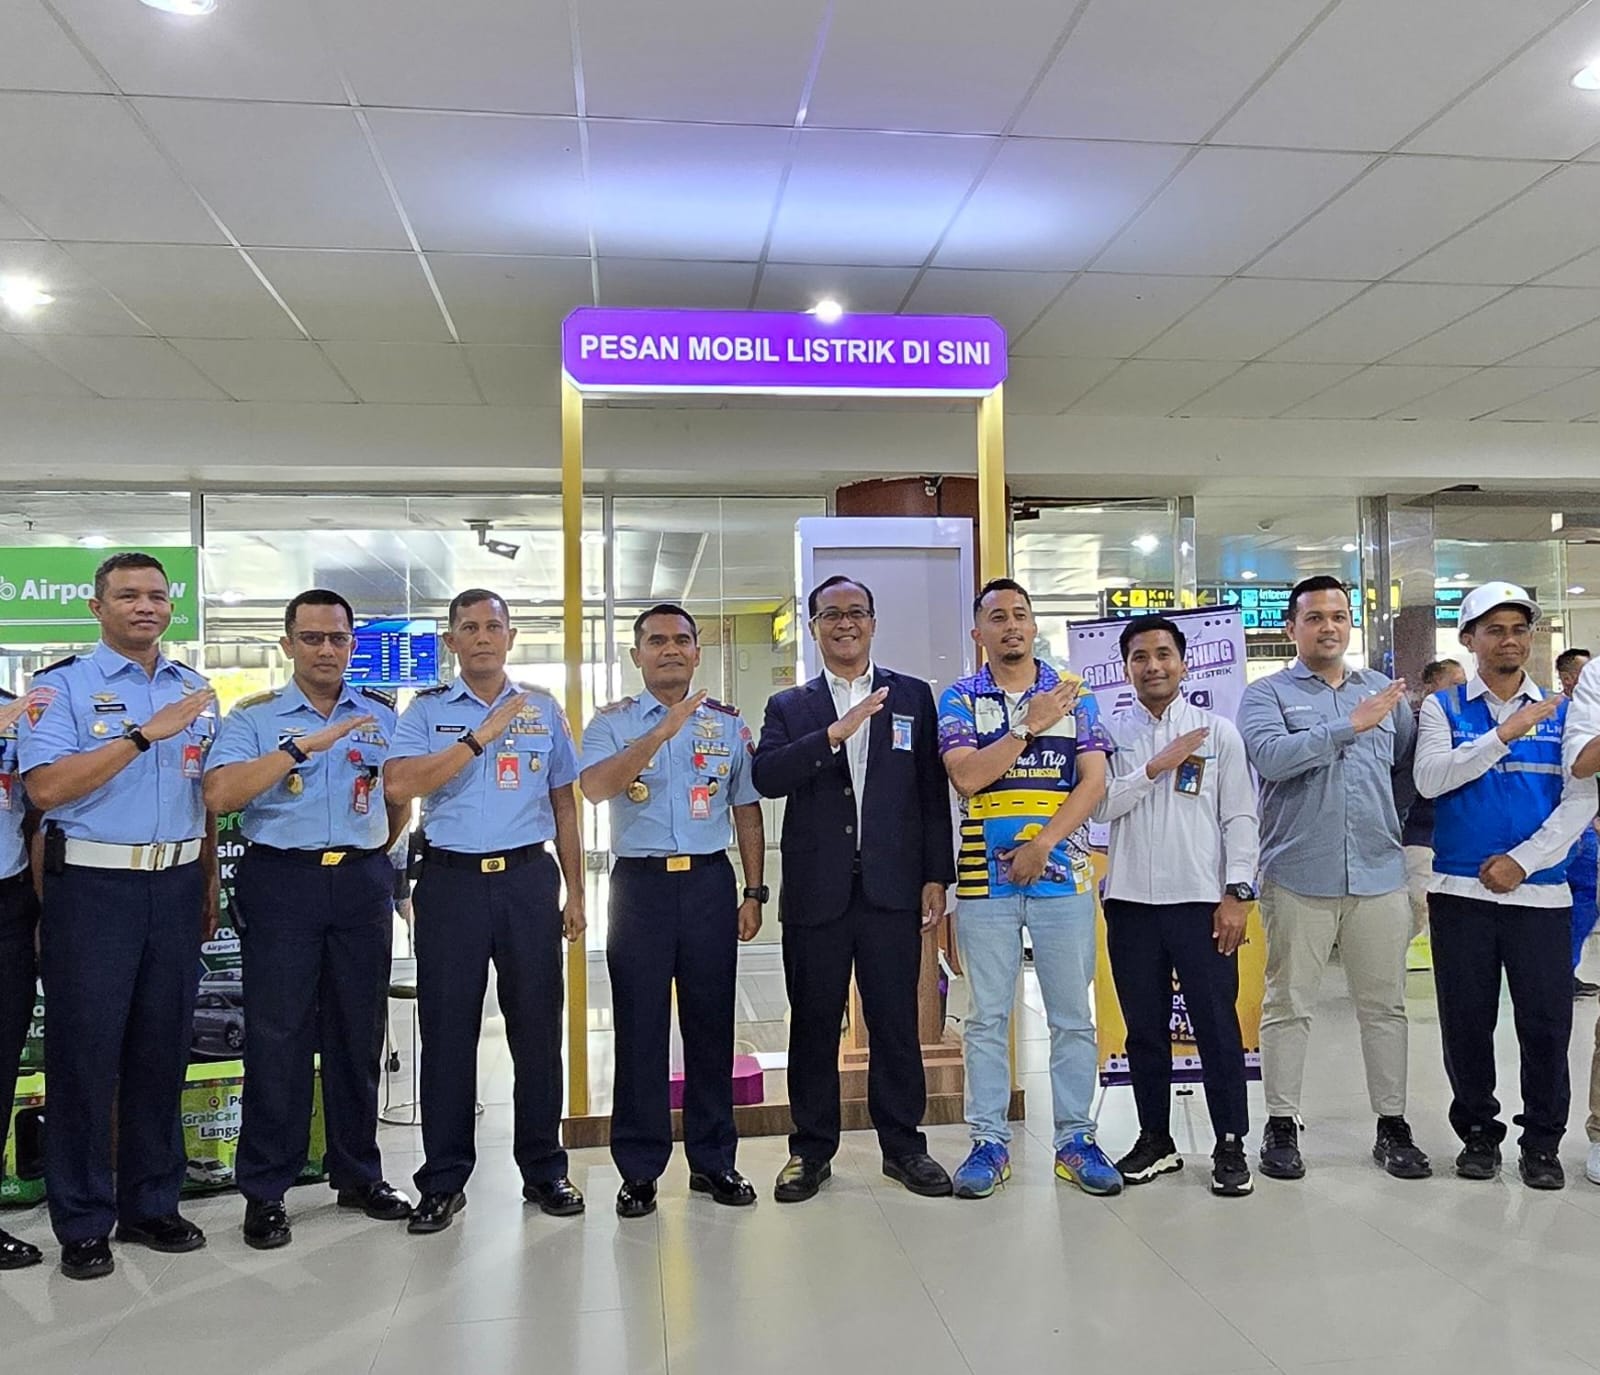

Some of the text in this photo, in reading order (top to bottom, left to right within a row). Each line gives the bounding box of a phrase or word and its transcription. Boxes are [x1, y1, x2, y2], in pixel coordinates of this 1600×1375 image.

[580, 335, 991, 366] PESAN MOBIL LISTRIK DI SINI
[20, 579, 96, 604] Airpo
[170, 614, 189, 625] rab
[1083, 640, 1234, 687] GRAN CHING
[1197, 667, 1232, 680] LISTRIK
[1041, 750, 1067, 770] Trip
[183, 1111, 238, 1125] GrabCar
[200, 1126, 239, 1139] Langs
